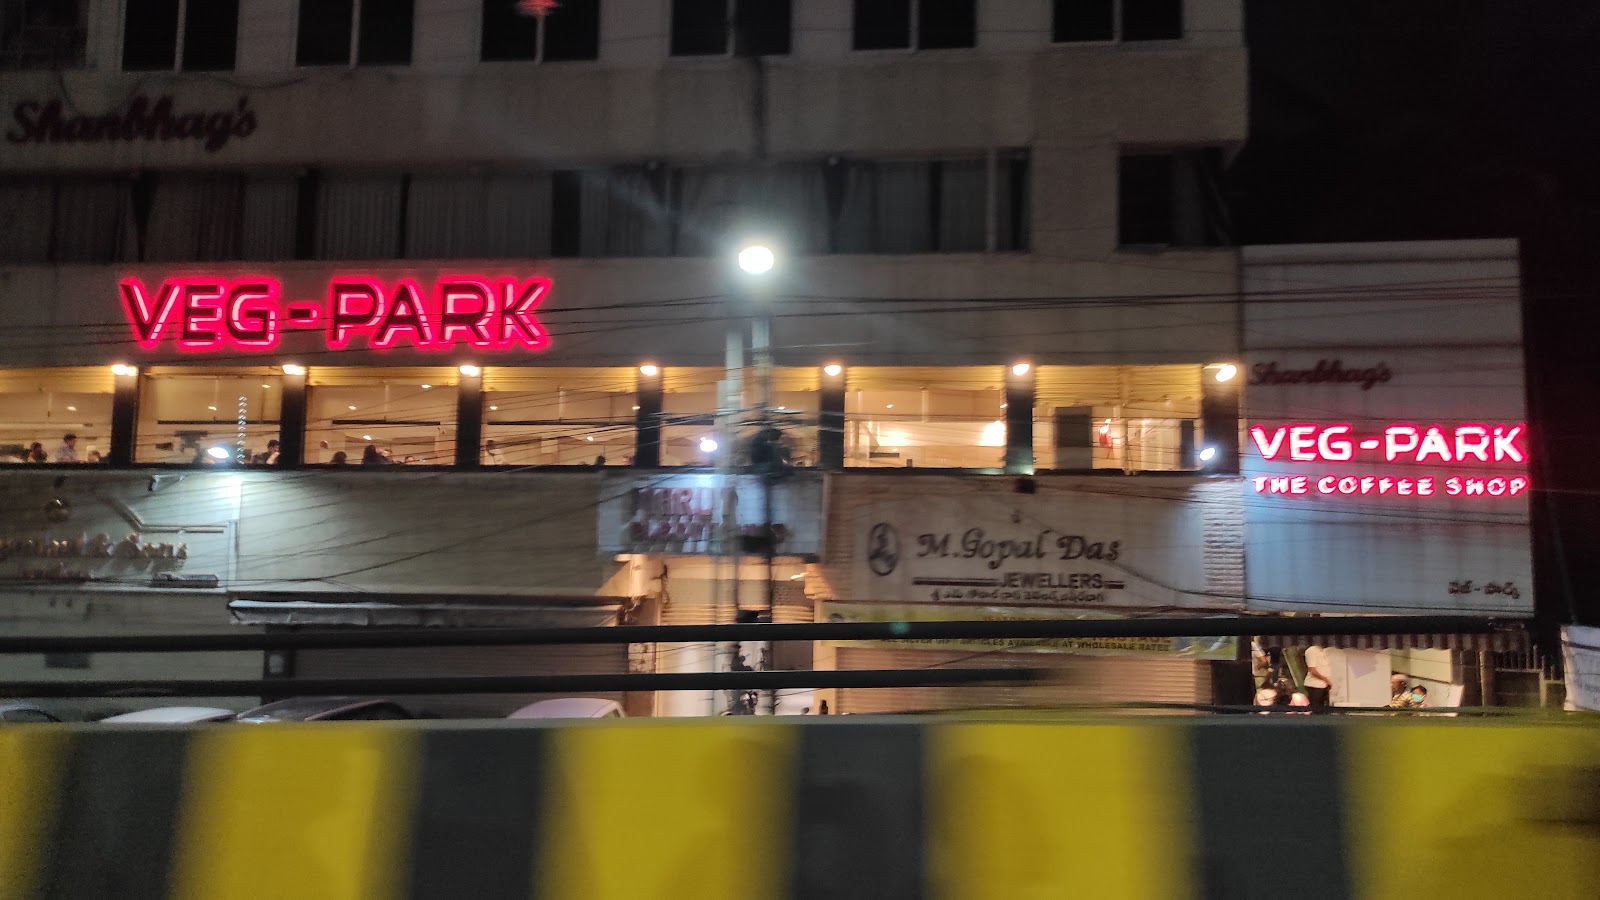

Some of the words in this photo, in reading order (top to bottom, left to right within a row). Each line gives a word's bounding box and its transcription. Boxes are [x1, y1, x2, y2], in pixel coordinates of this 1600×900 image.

[6, 95, 258, 152] Shanbhag's
[1251, 359, 1392, 391] Shanbhag's
[1251, 476, 1309, 495] THE
[1317, 476, 1435, 495] COFFEE
[1445, 476, 1528, 497] SHOP
[1056, 535, 1121, 560] Das
[1001, 572, 1103, 589] JEWELLERS
[1062, 641, 1073, 649] AT
[1077, 641, 1135, 651] WHOLESALE
